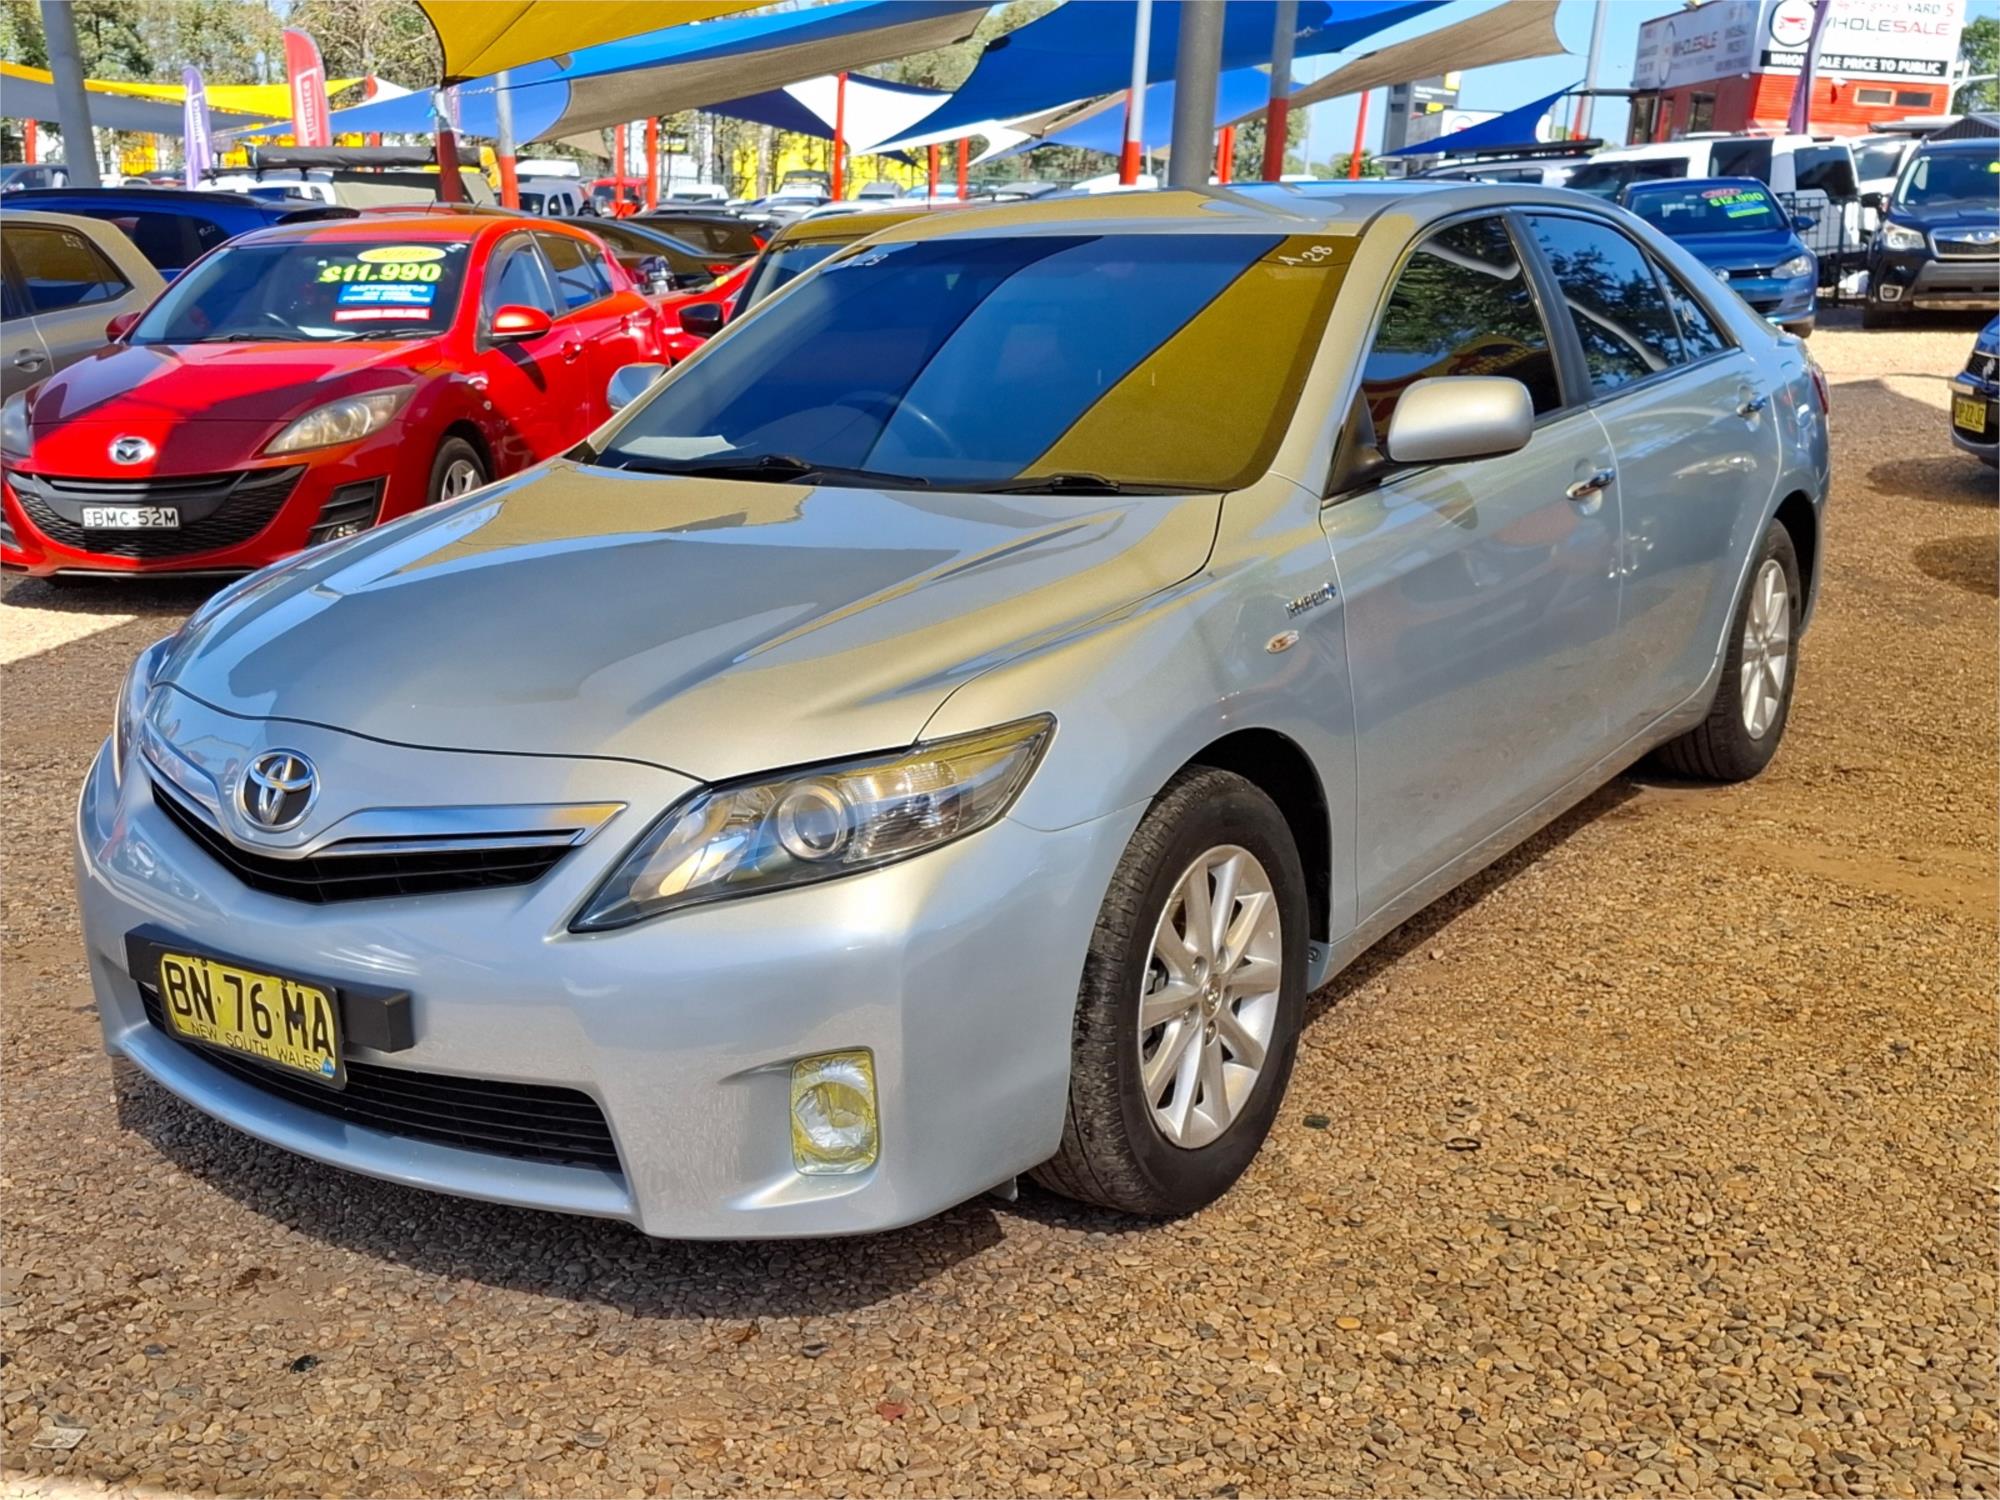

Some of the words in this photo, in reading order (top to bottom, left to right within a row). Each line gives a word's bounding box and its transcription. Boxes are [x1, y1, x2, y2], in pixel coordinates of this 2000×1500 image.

[1842, 57, 1878, 71] PRICE
[1880, 60, 1897, 73] TO
[1898, 60, 1942, 75] PUBLIC
[319, 262, 442, 283] $11.990
[190, 1022, 217, 1040] NEW
[225, 1032, 269, 1057] SOUTH
[276, 1045, 321, 1072] WALES
